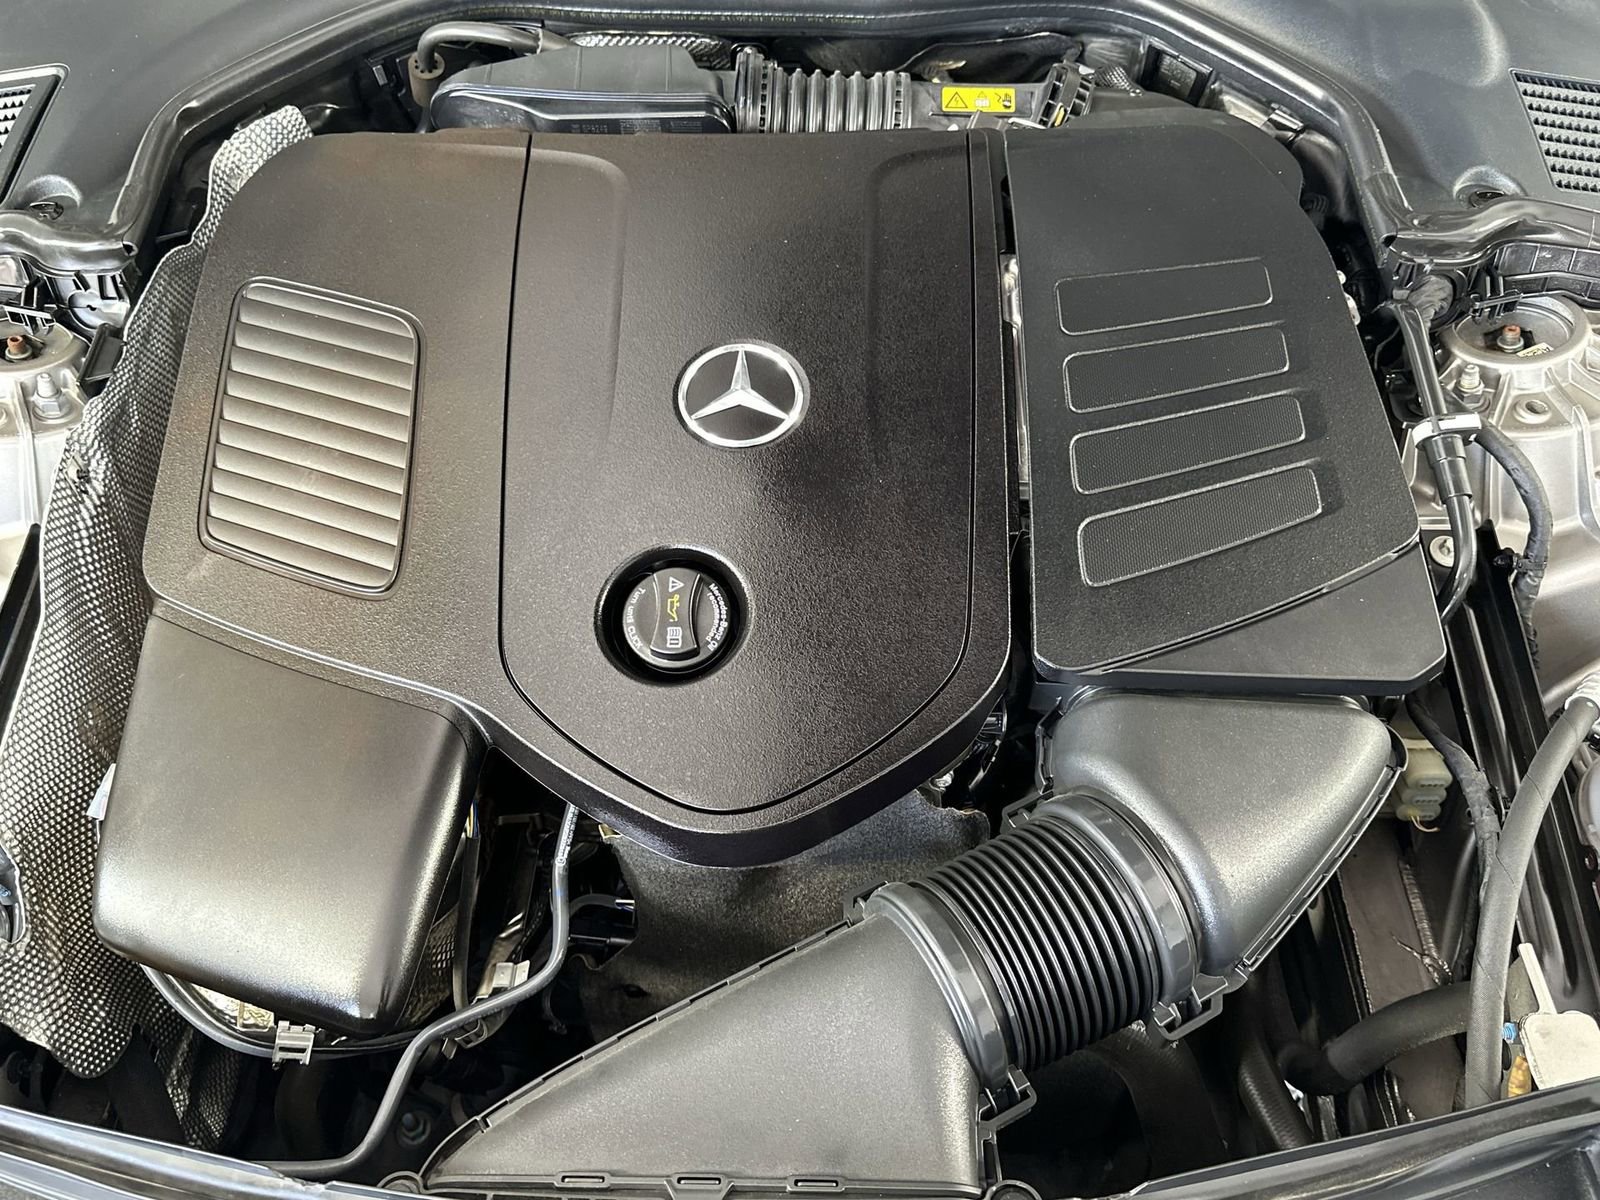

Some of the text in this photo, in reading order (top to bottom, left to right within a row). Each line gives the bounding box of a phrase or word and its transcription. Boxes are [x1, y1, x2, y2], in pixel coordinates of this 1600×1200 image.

[630, 587, 646, 604] Turn
[705, 592, 720, 642] recommended
[707, 583, 728, 652] Mercedes-Benz Oil
[628, 625, 643, 649] CLICK
